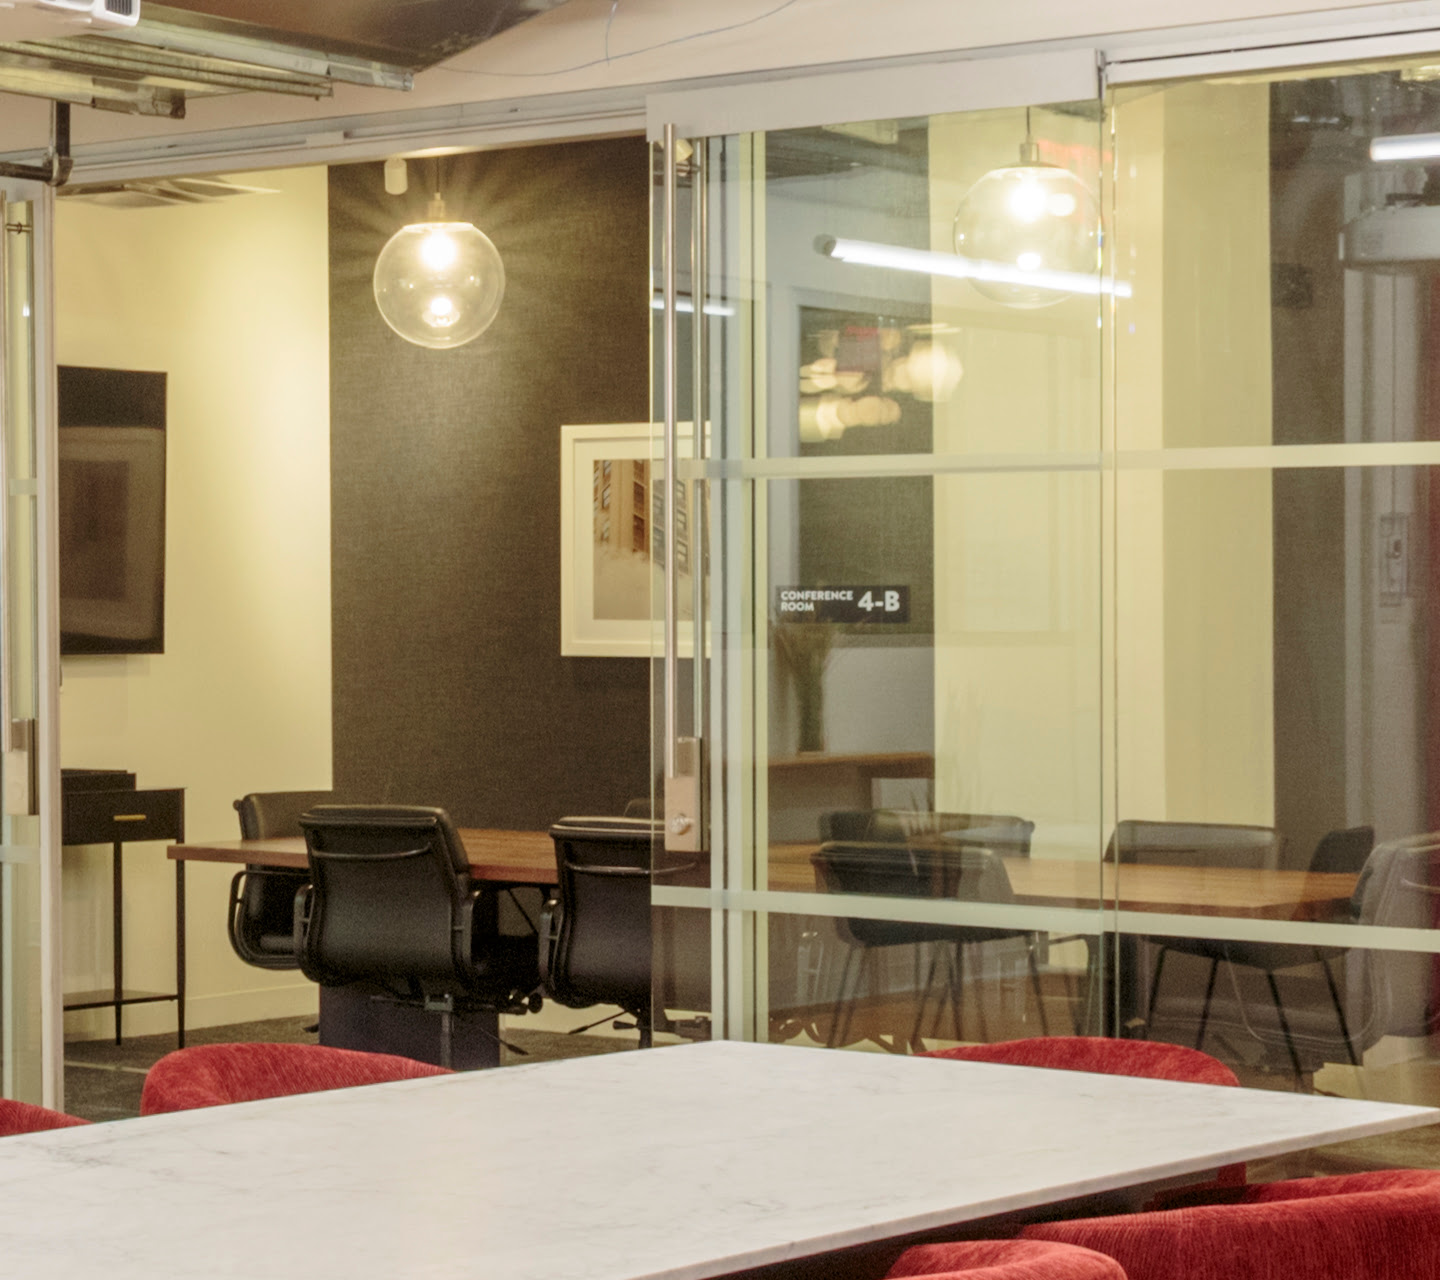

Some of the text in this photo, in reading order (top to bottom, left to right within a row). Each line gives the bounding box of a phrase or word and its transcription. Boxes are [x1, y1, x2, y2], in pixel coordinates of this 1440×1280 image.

[780, 590, 854, 601] CONFERENCE
[857, 590, 900, 612] 4-B
[781, 602, 815, 612] ROOM
